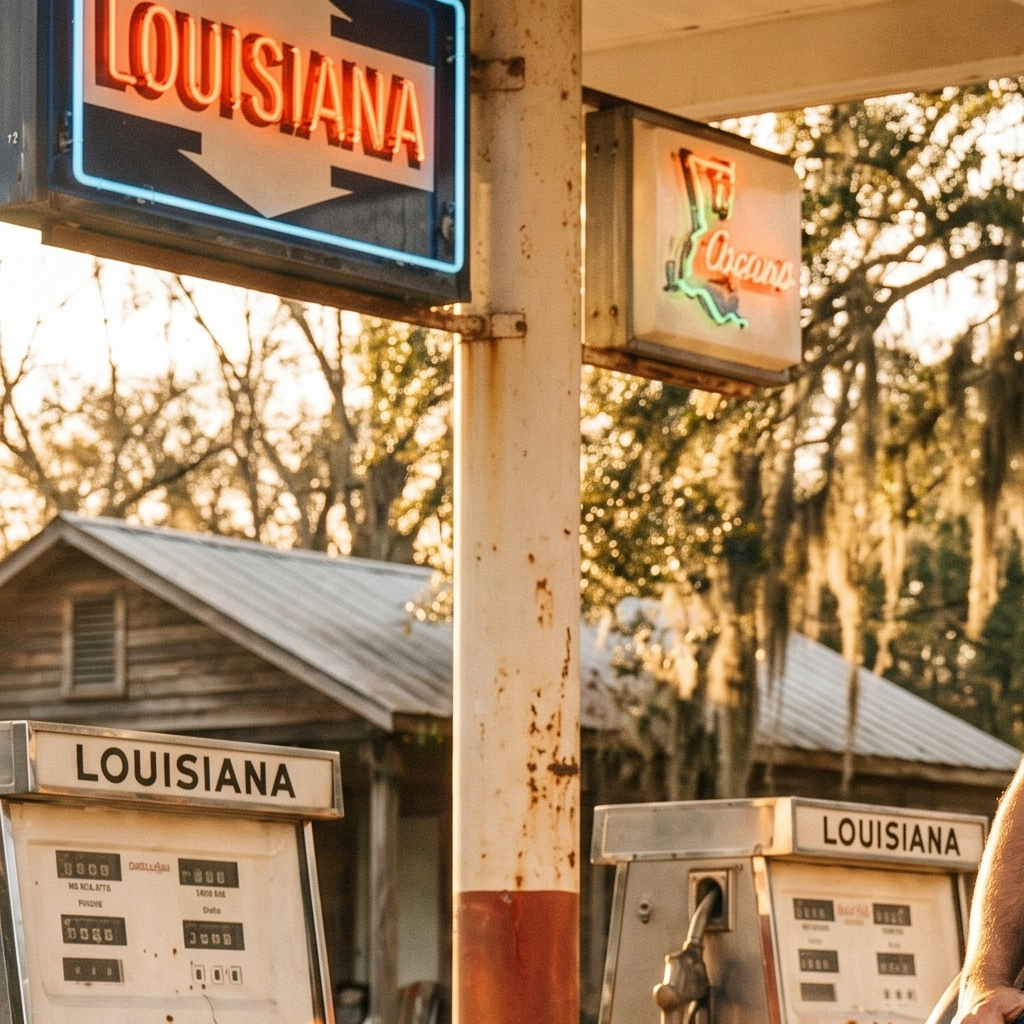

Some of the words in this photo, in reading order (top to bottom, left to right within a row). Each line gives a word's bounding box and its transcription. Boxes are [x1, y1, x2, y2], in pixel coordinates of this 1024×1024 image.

[95, 0, 426, 170] LOUISIANA
[76, 744, 296, 798] LOUISIANA
[823, 816, 961, 857] LOUISIANA
